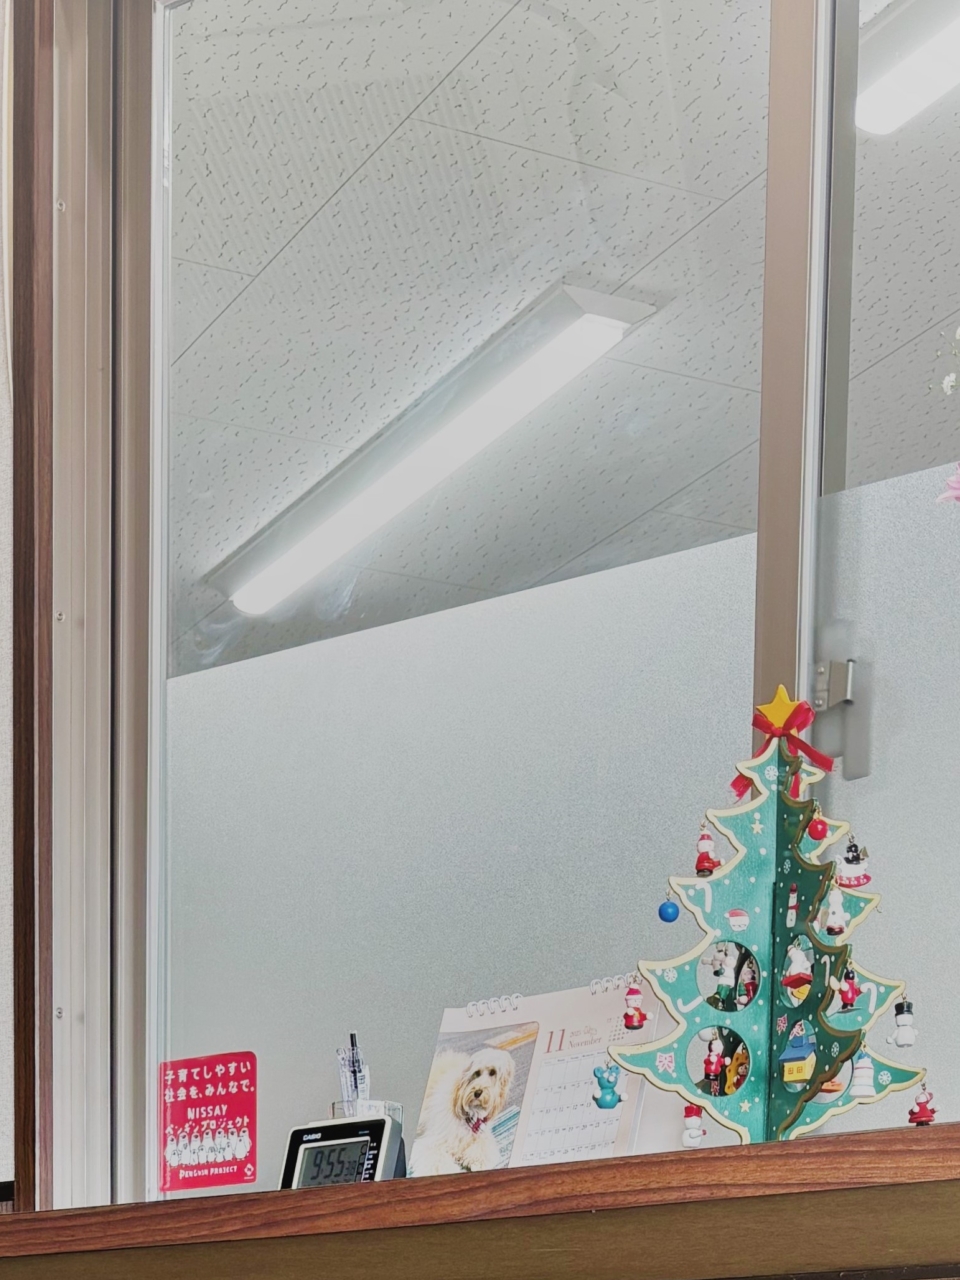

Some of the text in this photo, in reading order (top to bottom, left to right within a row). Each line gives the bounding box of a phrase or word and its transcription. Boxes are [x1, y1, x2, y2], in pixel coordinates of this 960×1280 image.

[543, 1028, 566, 1054] 11
[567, 1036, 602, 1050] November
[164, 1061, 251, 1085] 子育てしやすい
[164, 1079, 255, 1103] 社会を、みんなで。
[187, 1104, 228, 1120] NISSAY
[165, 1115, 250, 1135] ペンギンプロジェクト
[303, 1133, 321, 1141] CASIO
